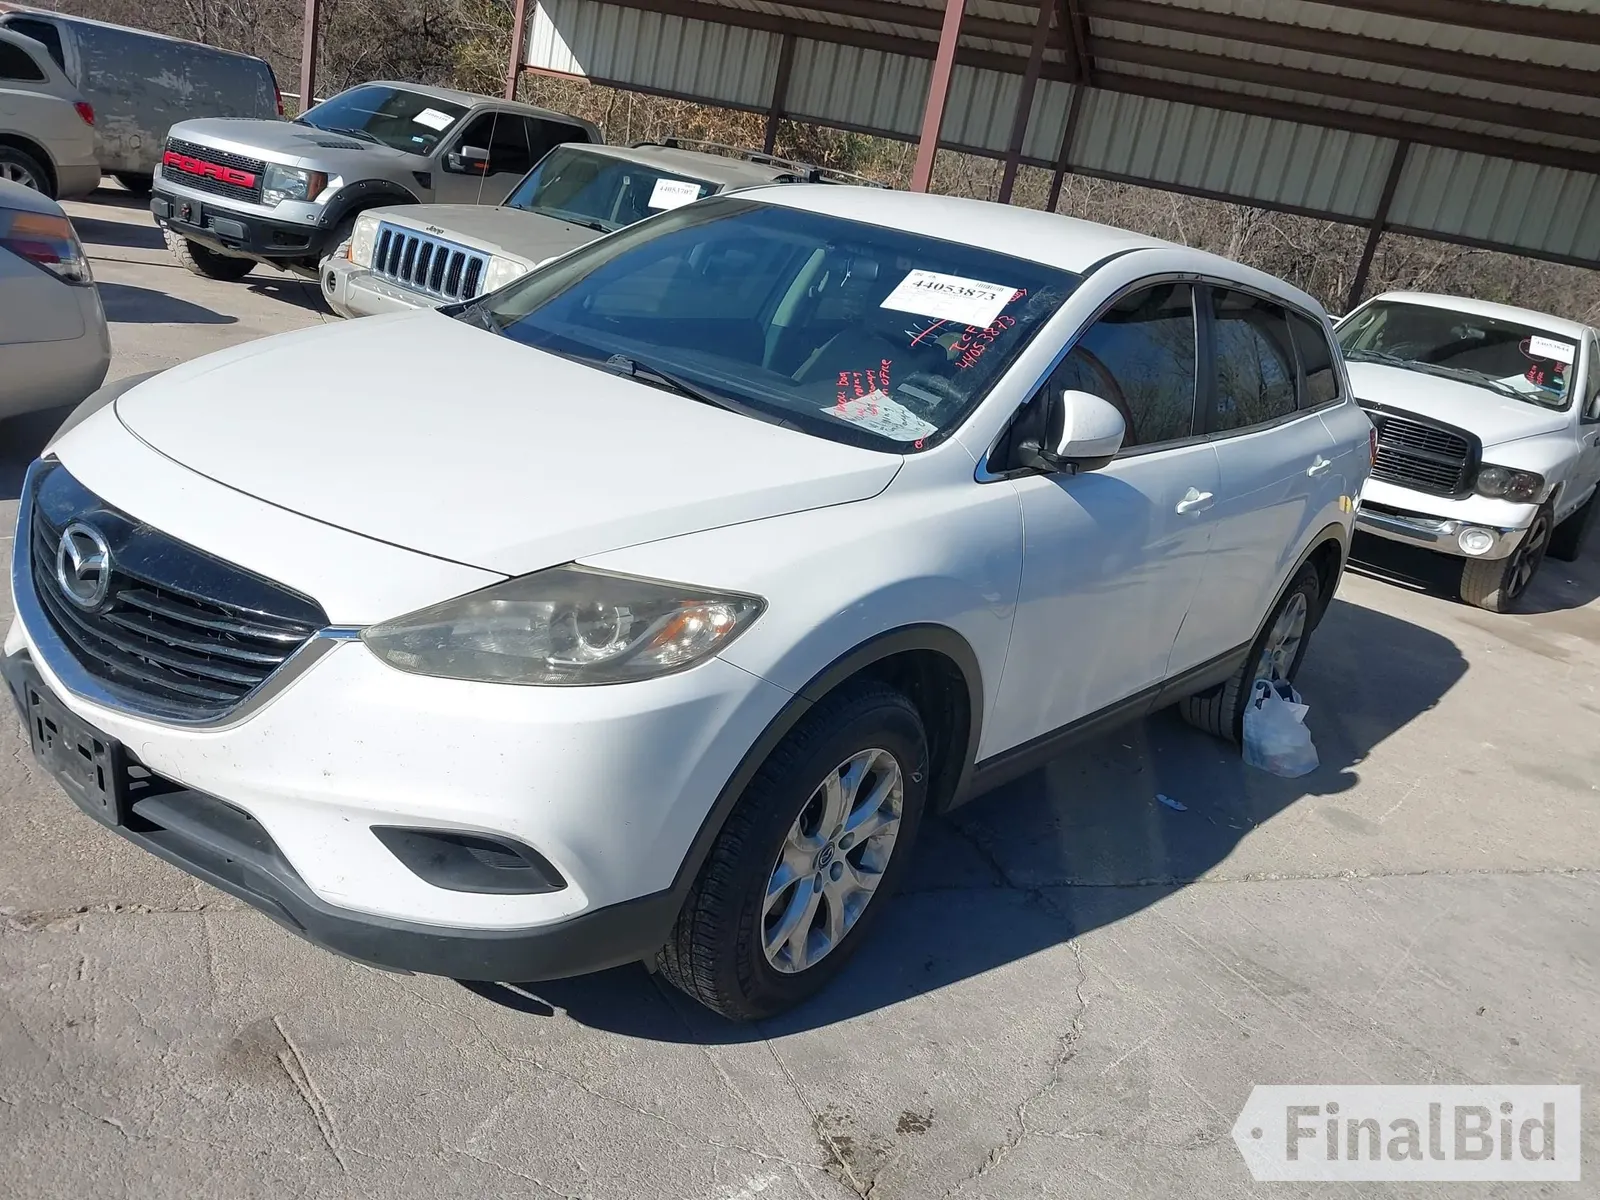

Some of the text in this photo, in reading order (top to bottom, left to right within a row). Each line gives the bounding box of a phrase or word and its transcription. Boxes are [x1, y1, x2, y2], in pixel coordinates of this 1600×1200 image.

[163, 150, 256, 188] FORD
[425, 225, 445, 235] Jeep
[912, 280, 997, 301] 44053873
